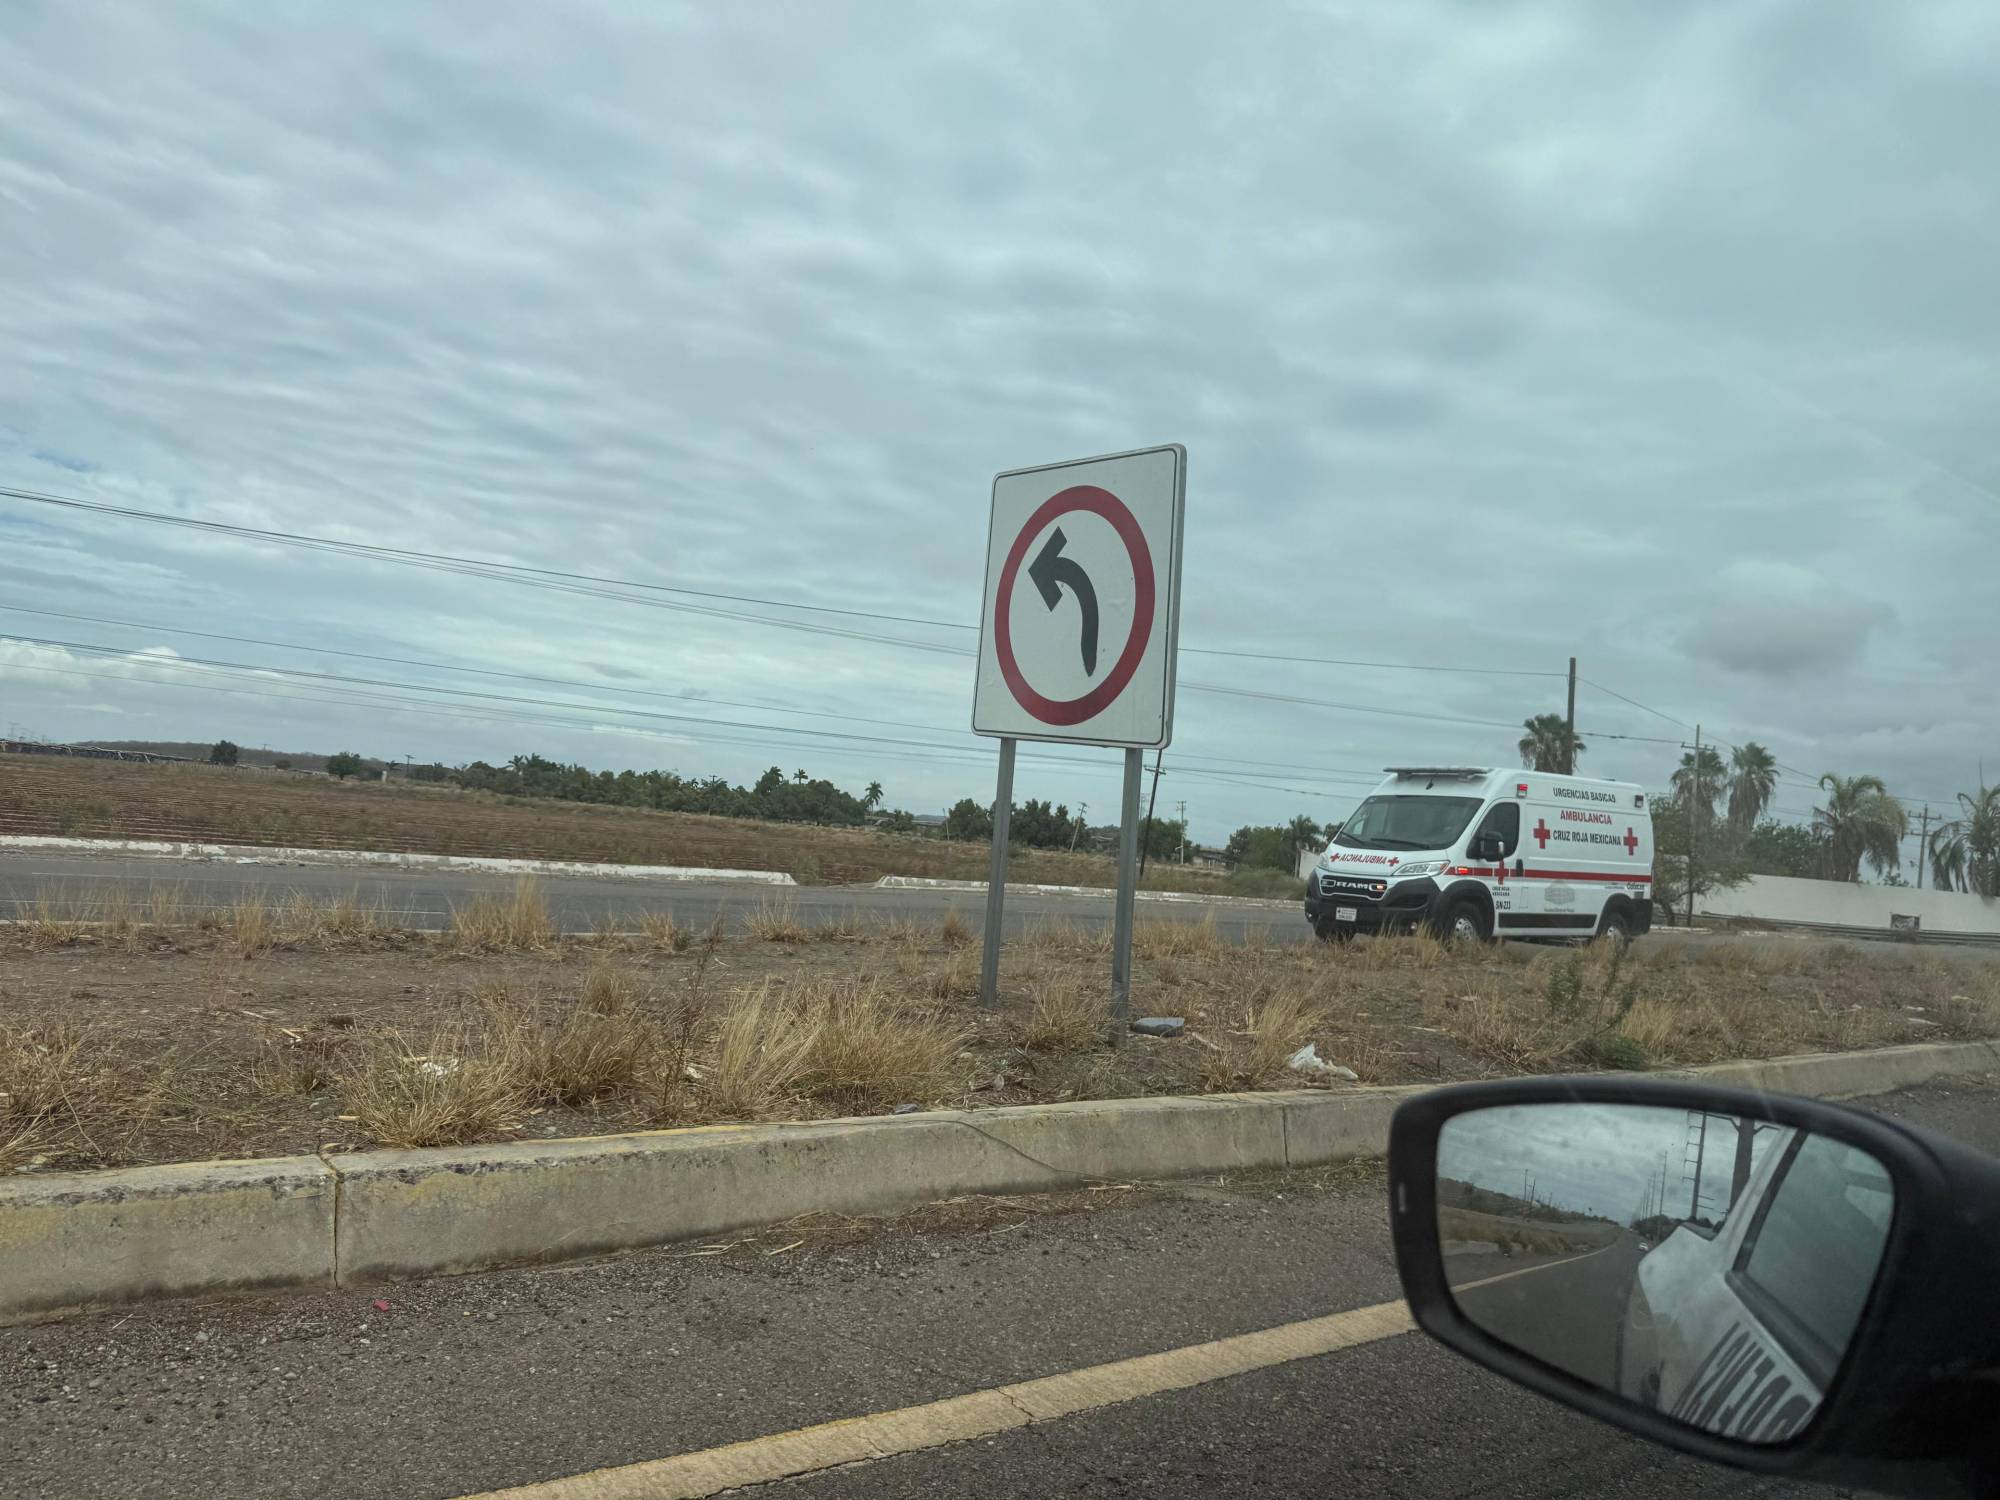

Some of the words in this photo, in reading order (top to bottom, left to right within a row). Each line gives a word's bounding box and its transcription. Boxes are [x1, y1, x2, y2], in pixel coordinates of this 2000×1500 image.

[1553, 788, 1589, 800] URGENCIAS
[1590, 791, 1616, 803] BASICAS
[1560, 810, 1612, 825] AMBULANCIA
[1553, 830, 1570, 841] CRUZ
[1572, 831, 1588, 842] ROJA
[1590, 833, 1621, 846] MEXICANA
[1336, 881, 1369, 889] RAM
